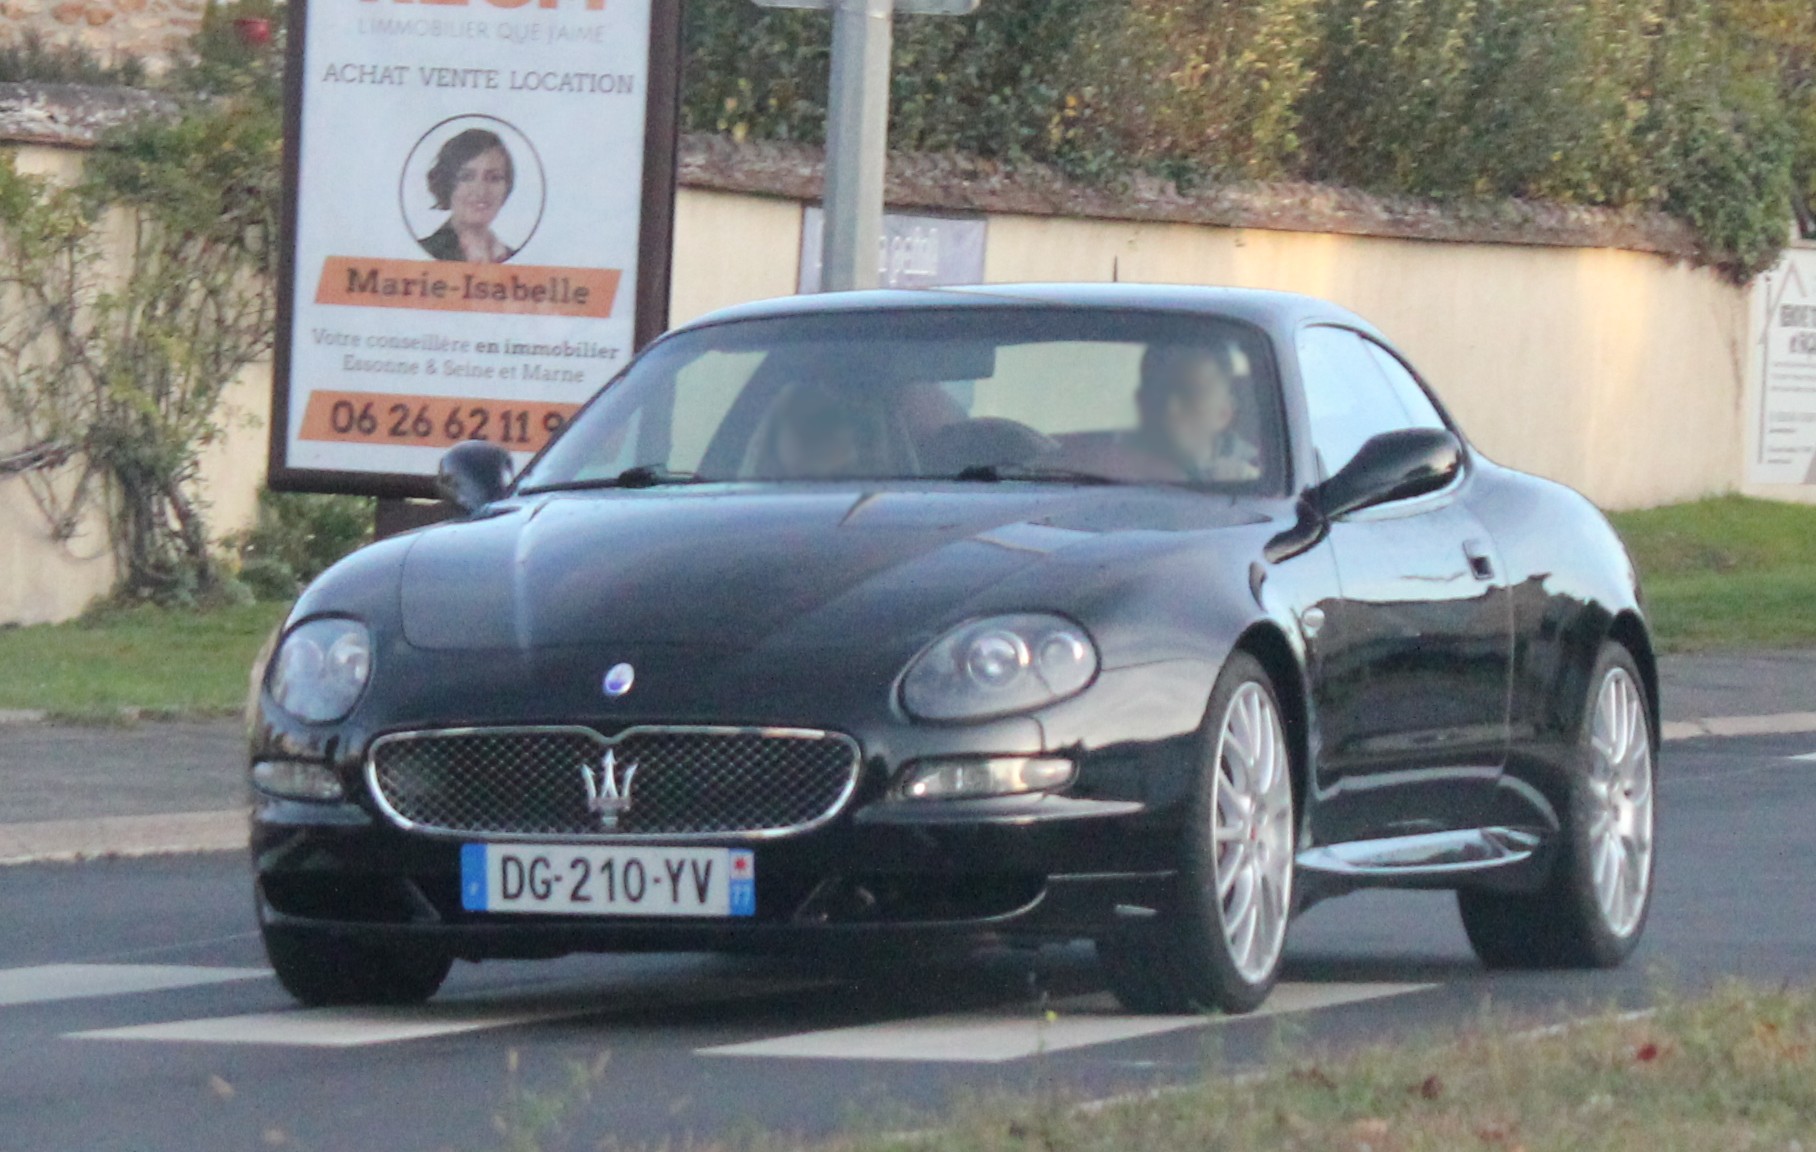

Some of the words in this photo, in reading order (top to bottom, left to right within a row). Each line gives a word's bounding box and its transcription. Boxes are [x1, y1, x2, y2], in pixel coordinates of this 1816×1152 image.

[500, 22, 540, 43] QUE
[322, 63, 409, 85] ACHAT
[419, 67, 498, 89] VENTE
[509, 70, 634, 94] LOCATION
[346, 267, 590, 304] Marie-Isabelle
[311, 327, 361, 346] Votre
[475, 341, 499, 353] en
[504, 338, 619, 359] immobilier
[343, 354, 419, 374] Essonne
[425, 358, 436, 375] &
[443, 358, 495, 378] Seine
[499, 365, 516, 379] et
[521, 364, 585, 382] Marne
[330, 400, 377, 435] 06
[388, 404, 432, 437] 26
[444, 405, 490, 441] 62
[500, 410, 530, 443] 11
[501, 855, 713, 903] DG-210-YV
